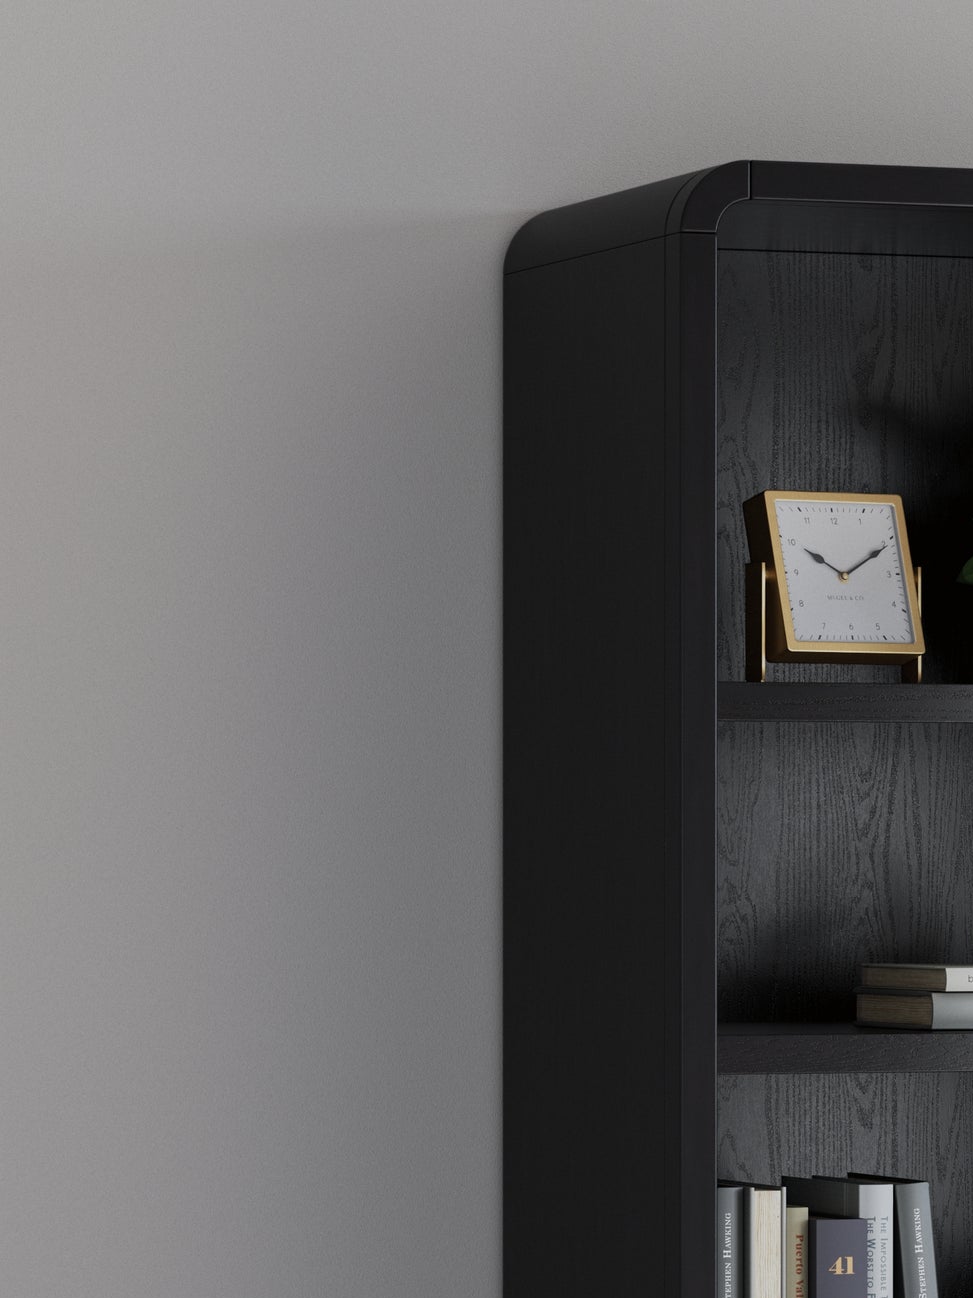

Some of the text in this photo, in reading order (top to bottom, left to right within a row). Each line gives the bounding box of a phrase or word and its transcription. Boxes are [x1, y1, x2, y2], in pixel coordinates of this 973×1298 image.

[830, 517, 838, 525] 12
[787, 538, 796, 546] 10
[793, 568, 799, 576] 9
[886, 570, 892, 578] 3
[722, 1212, 732, 1258] HAWKING
[913, 1207, 924, 1254] HAWKING
[795, 1234, 804, 1275] Puerto
[828, 1256, 855, 1275] 41
